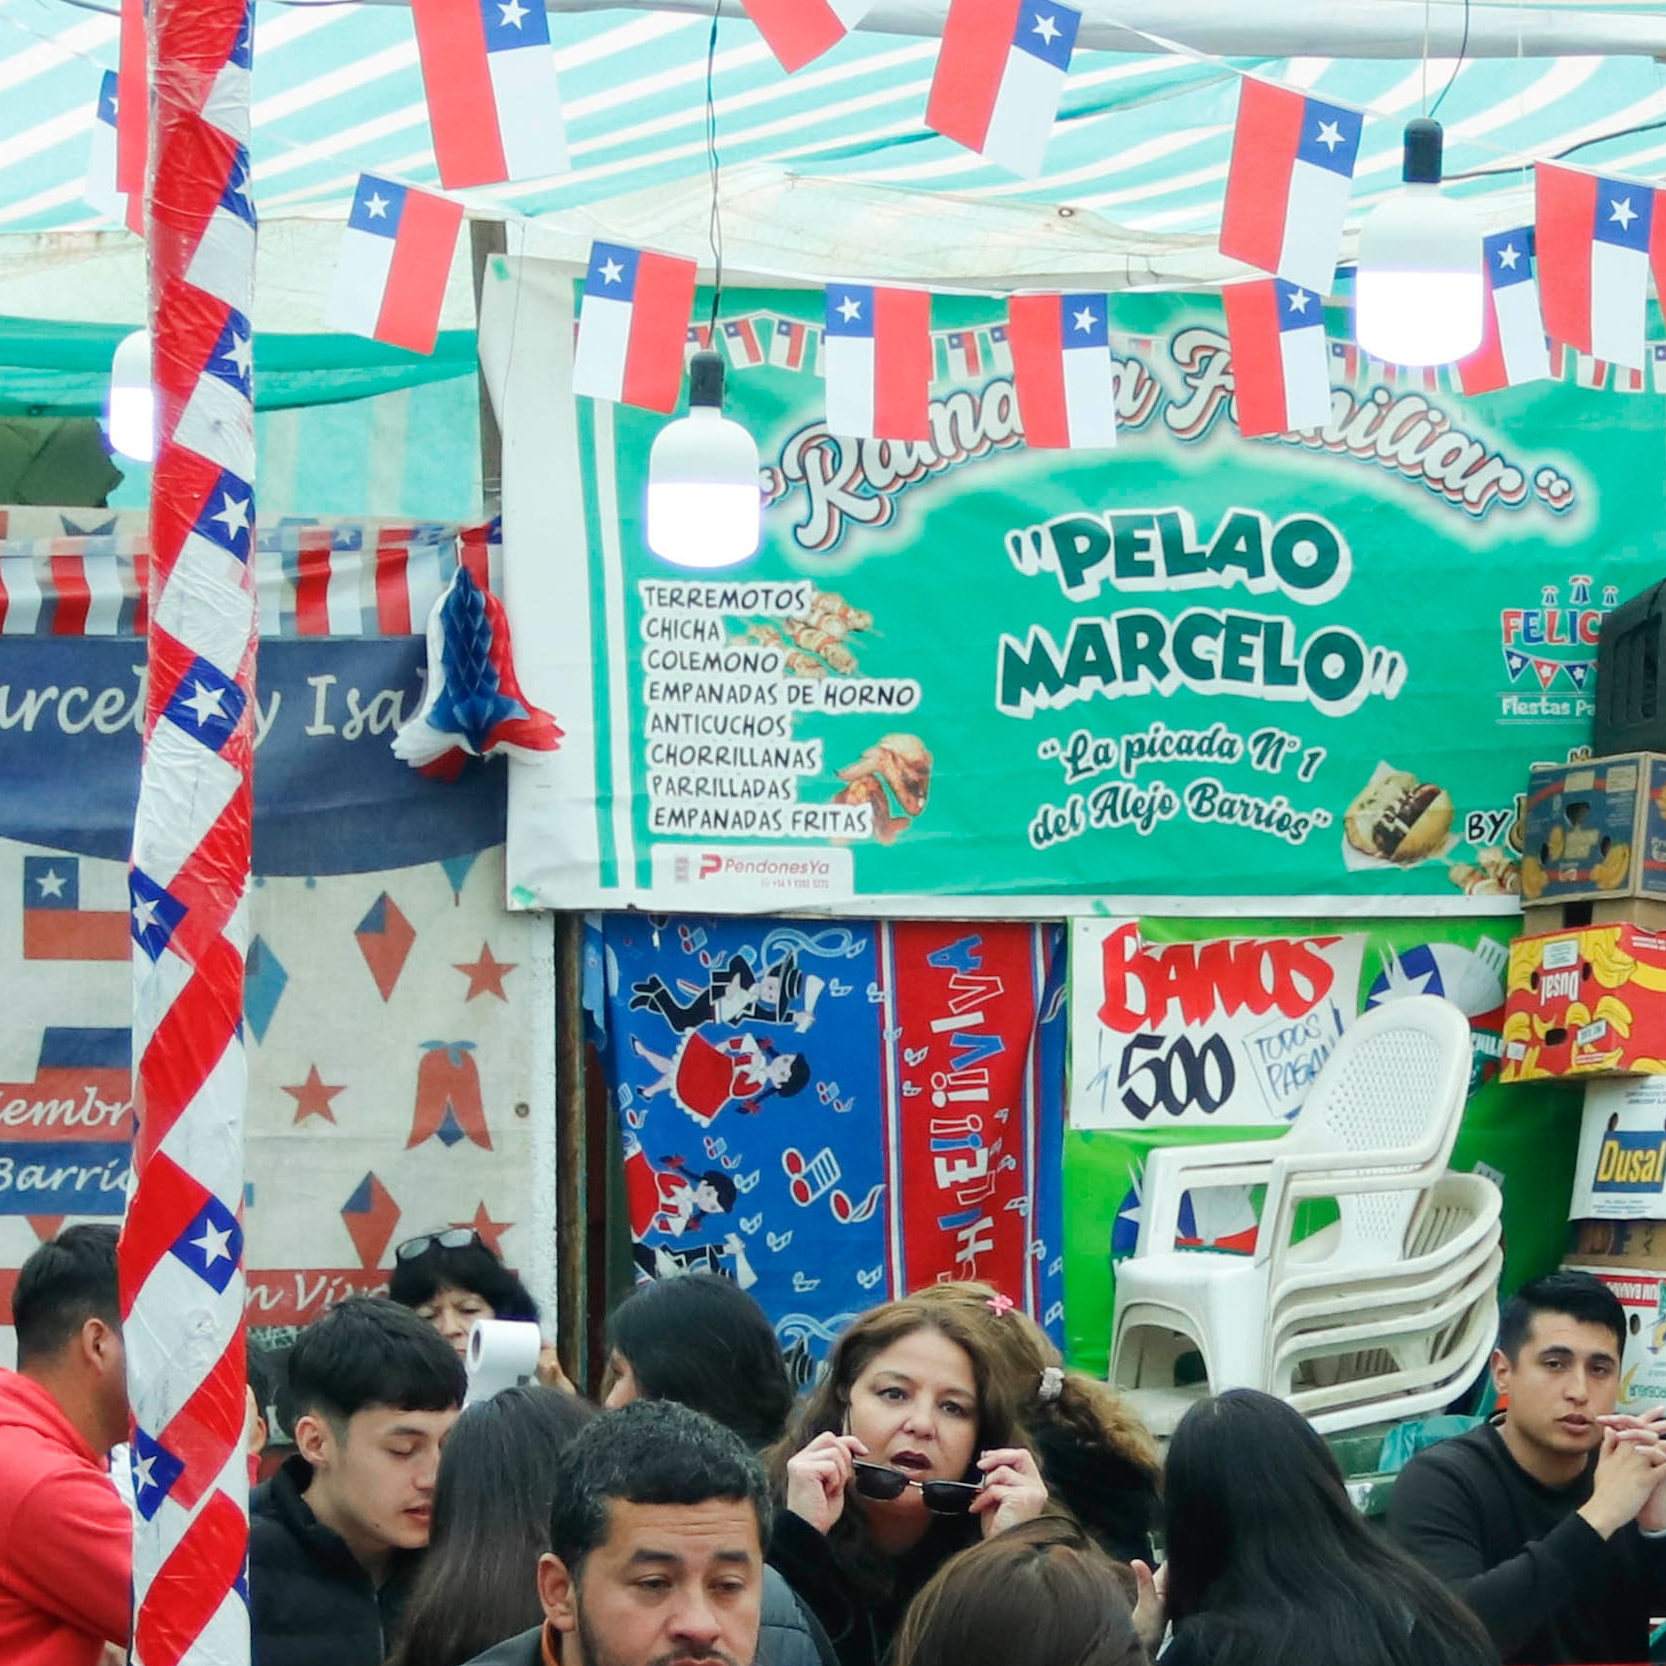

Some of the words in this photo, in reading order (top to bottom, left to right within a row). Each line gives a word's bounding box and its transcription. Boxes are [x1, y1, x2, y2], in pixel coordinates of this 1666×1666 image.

[644, 586, 806, 611] TERREMOTOS
[646, 618, 720, 640] CHICHA
[1501, 609, 1611, 645] FELIC
[647, 650, 779, 673] COLEMONO
[305, 667, 425, 741] Isa
[649, 682, 778, 704] EMPANADAS
[787, 684, 814, 704] DE
[824, 685, 915, 707] HORNO
[1501, 695, 1571, 715] Fiestas
[650, 713, 786, 737] ANTICUCHOS
[650, 745, 816, 769] CHORRILLANAS
[1124, 726, 1240, 776] picada
[1301, 749, 1324, 780] 1
[652, 776, 791, 800] PARRILLADAS
[654, 807, 783, 831] EMPANADAS
[791, 810, 867, 832] FRITAS
[1033, 799, 1083, 848] del
[1094, 782, 1175, 832] Alejo
[1467, 811, 1510, 843] BY
[1540, 970, 1580, 1006] Dusal
[1255, 1013, 1322, 1063] TODOS
[1117, 1033, 1236, 1121] 500
[245, 1288, 284, 1311] n
